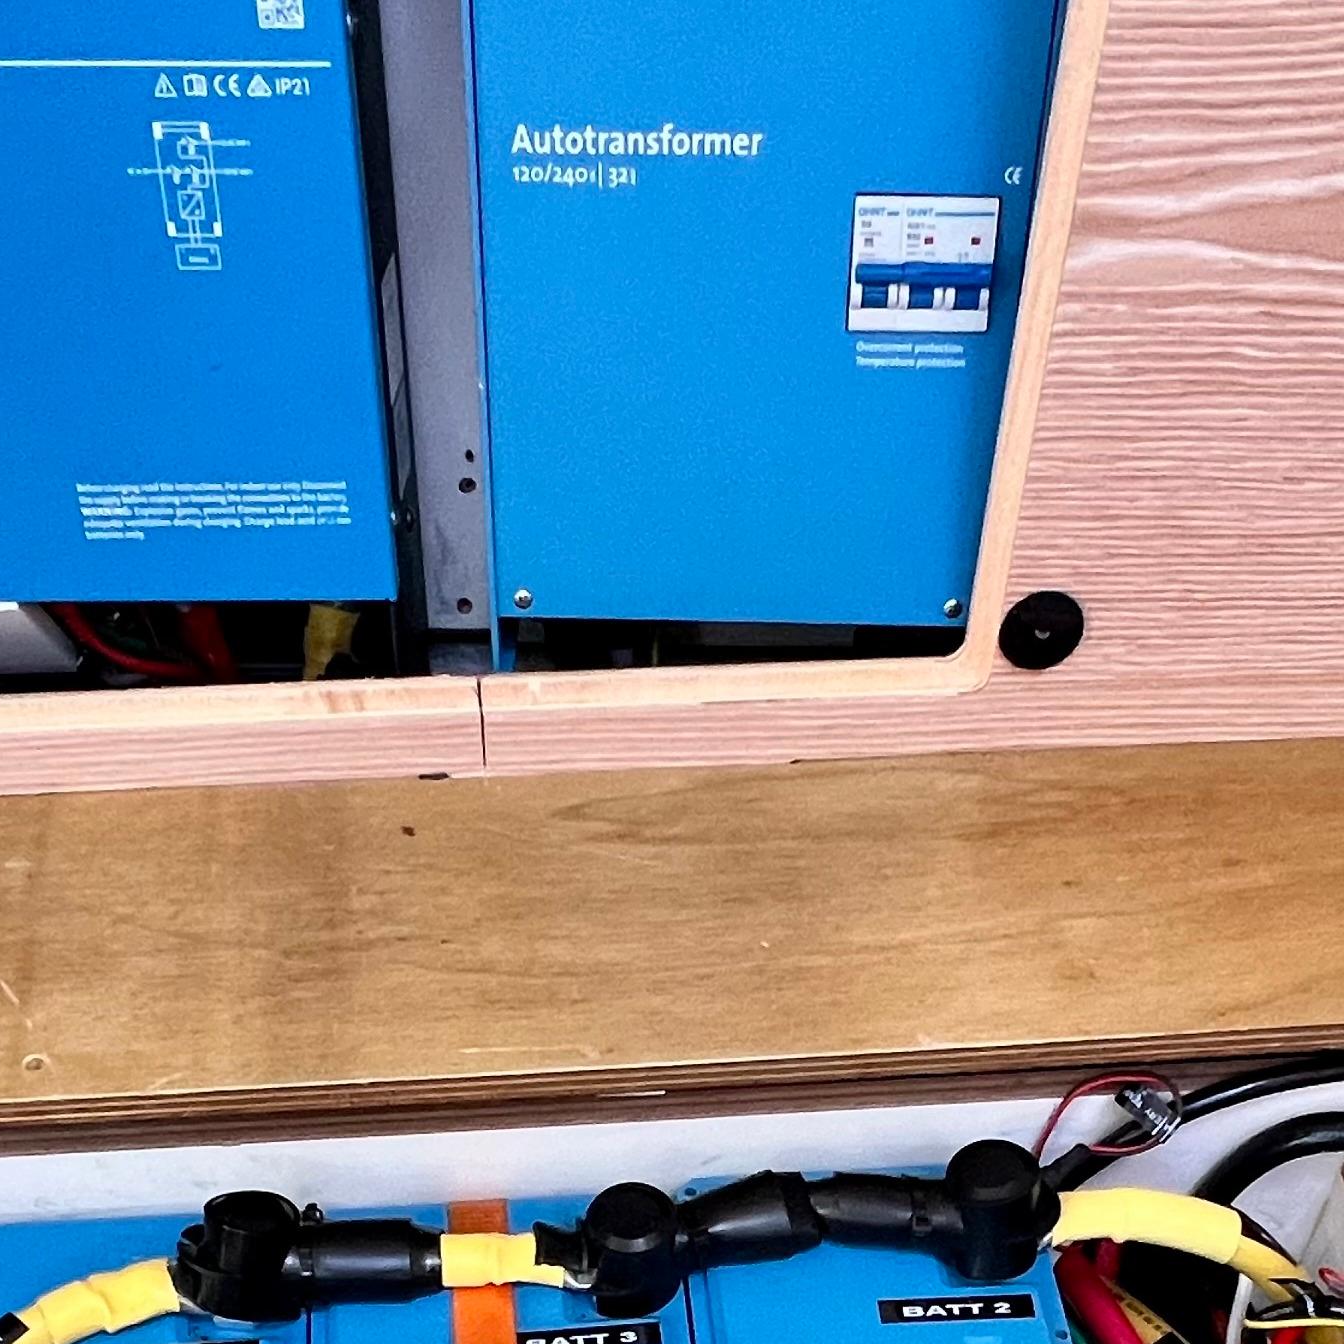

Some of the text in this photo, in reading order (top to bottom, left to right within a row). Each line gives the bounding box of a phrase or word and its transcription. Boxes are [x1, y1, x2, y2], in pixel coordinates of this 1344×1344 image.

[275, 77, 310, 96] IP21
[512, 123, 763, 157] Autotransformer
[902, 1302, 1011, 1318] BATT 2
[619, 1331, 638, 1344] 3
